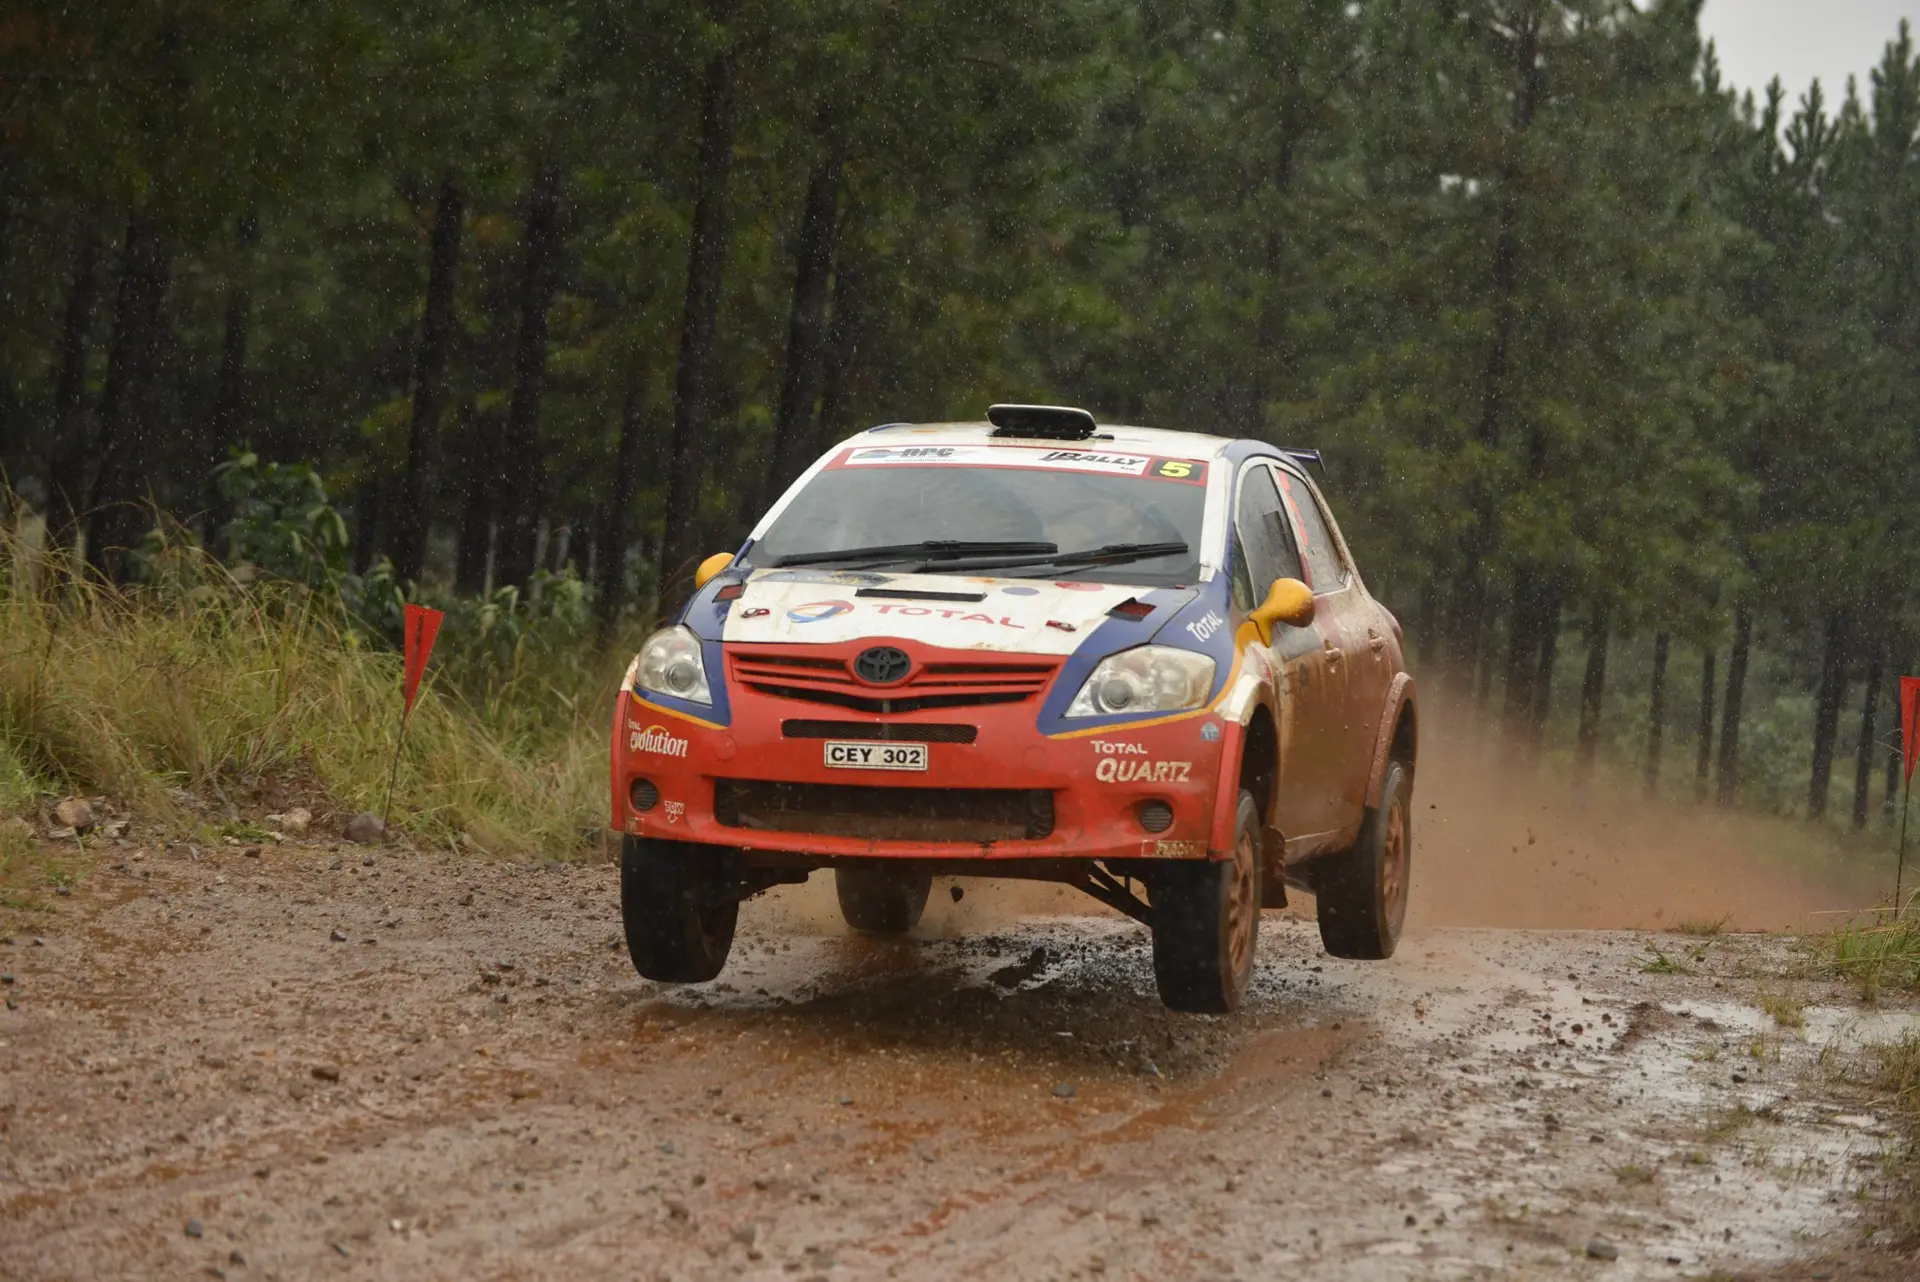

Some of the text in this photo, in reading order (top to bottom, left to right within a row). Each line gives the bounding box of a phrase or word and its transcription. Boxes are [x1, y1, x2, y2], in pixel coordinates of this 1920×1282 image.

[1159, 460, 1193, 479] 5
[872, 604, 1025, 629] TOTAL
[1185, 609, 1224, 643] TOTAL
[630, 729, 689, 758] evolution
[831, 746, 921, 764] CEY 302
[1090, 740, 1148, 754] TOTAL
[1095, 757, 1193, 783] QUARTZ
